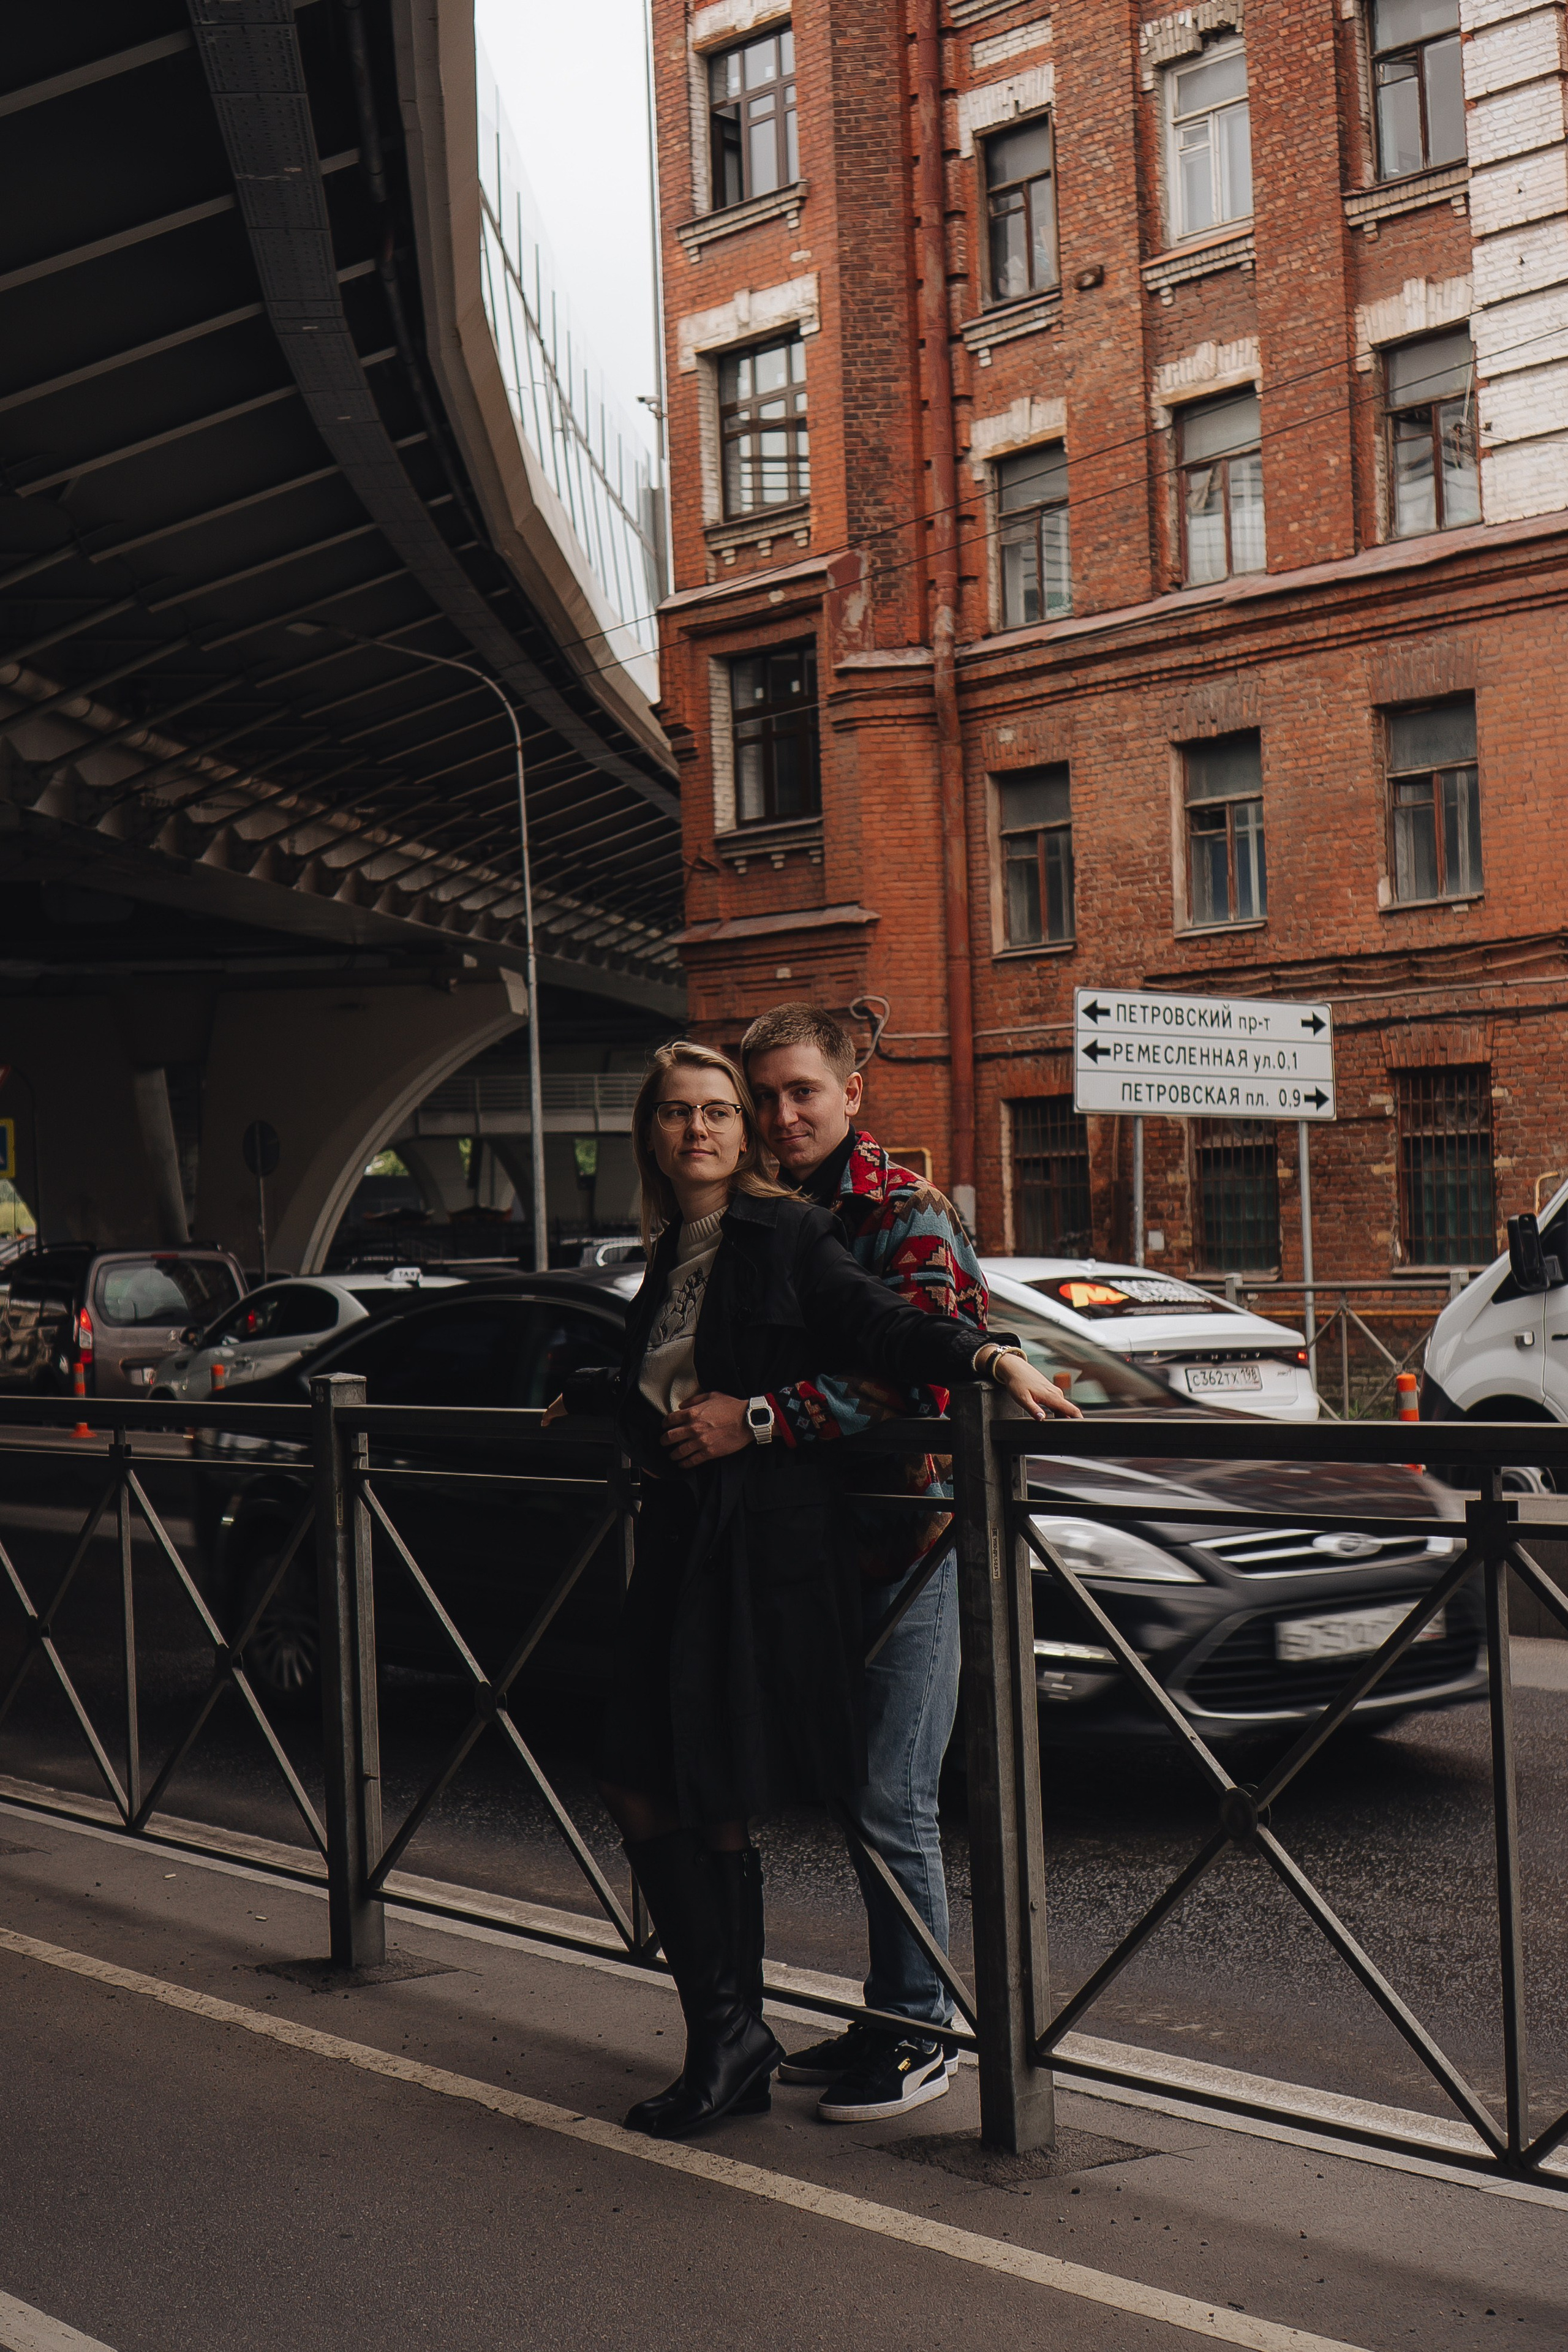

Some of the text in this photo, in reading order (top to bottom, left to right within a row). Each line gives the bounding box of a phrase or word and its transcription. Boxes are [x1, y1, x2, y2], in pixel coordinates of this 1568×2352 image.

[1117, 1003, 1270, 1035] ПЕТРОВСКИЙ пр-т
[1114, 1042, 1248, 1068] РЕМЕСЛЕННАЯ
[1121, 1083, 1301, 1109] ПЕТРОВСКАЯ пл. 0,9
